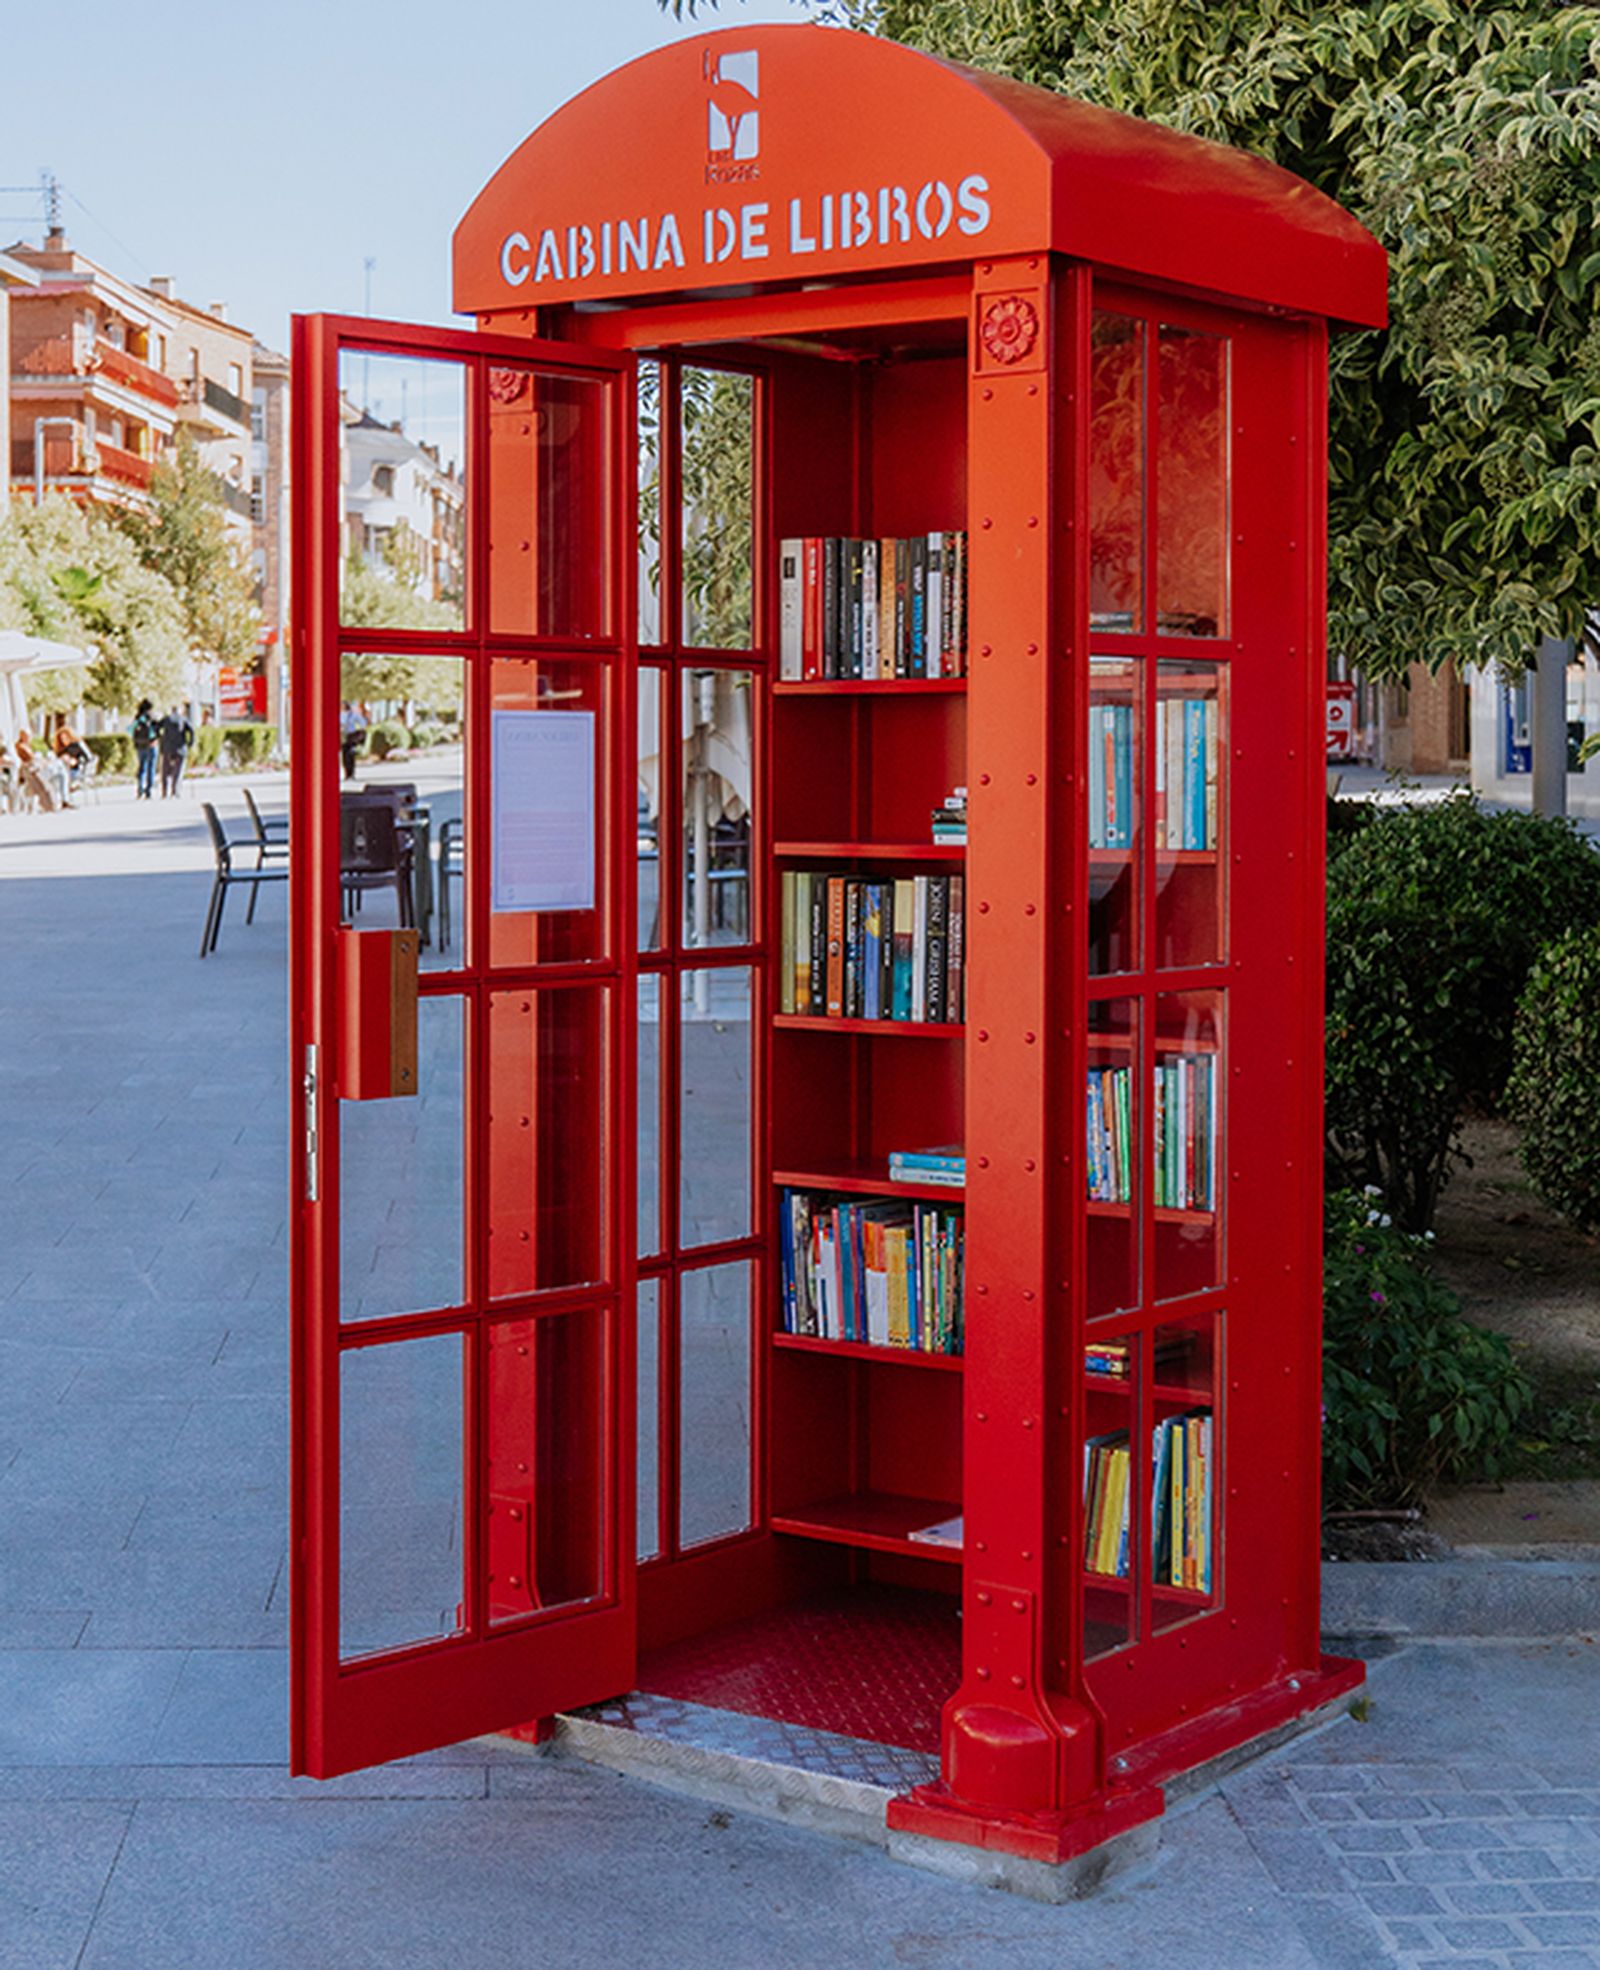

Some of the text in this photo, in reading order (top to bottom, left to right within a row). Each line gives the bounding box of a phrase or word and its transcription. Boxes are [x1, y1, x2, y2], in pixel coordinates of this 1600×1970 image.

[500, 174, 991, 288] CABINA DE LIBROS
